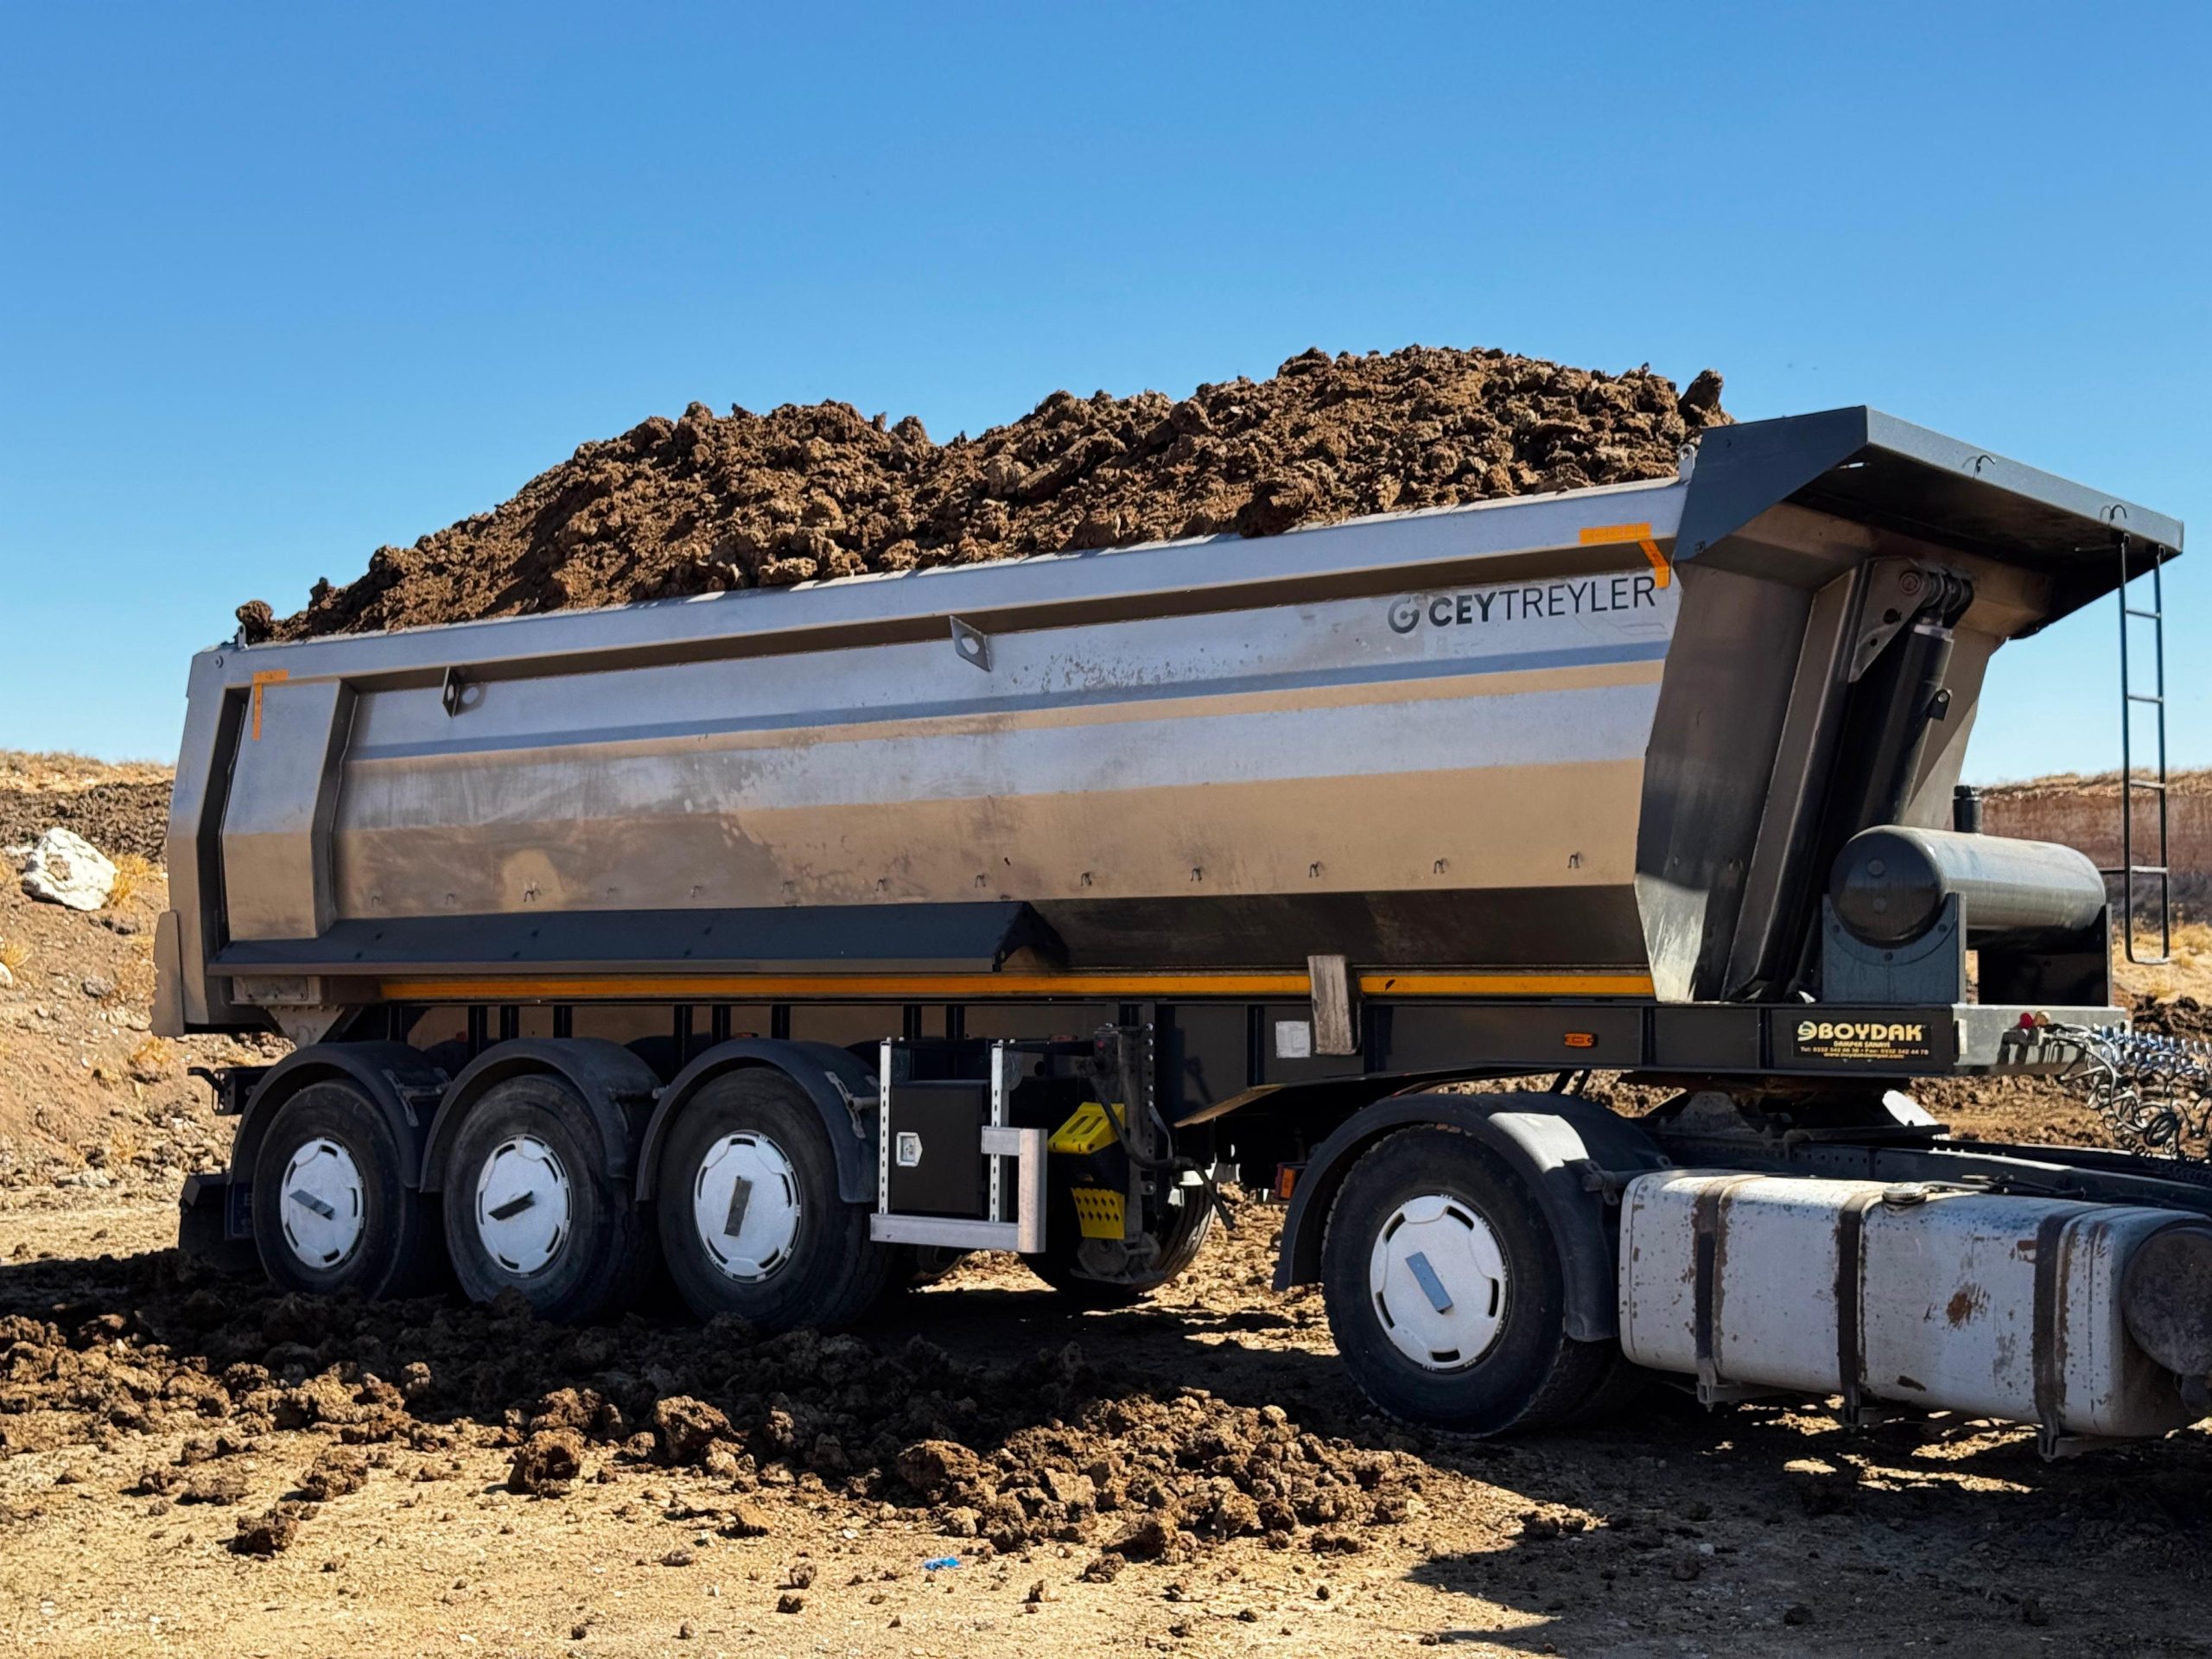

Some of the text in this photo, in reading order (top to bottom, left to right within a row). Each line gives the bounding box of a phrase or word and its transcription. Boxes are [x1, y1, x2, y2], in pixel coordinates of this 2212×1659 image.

[1428, 576, 1656, 627] CEYTREYLER
[1818, 1022, 1923, 1042] BOYDAK
[1833, 1039, 1864, 1048] DAMPER
